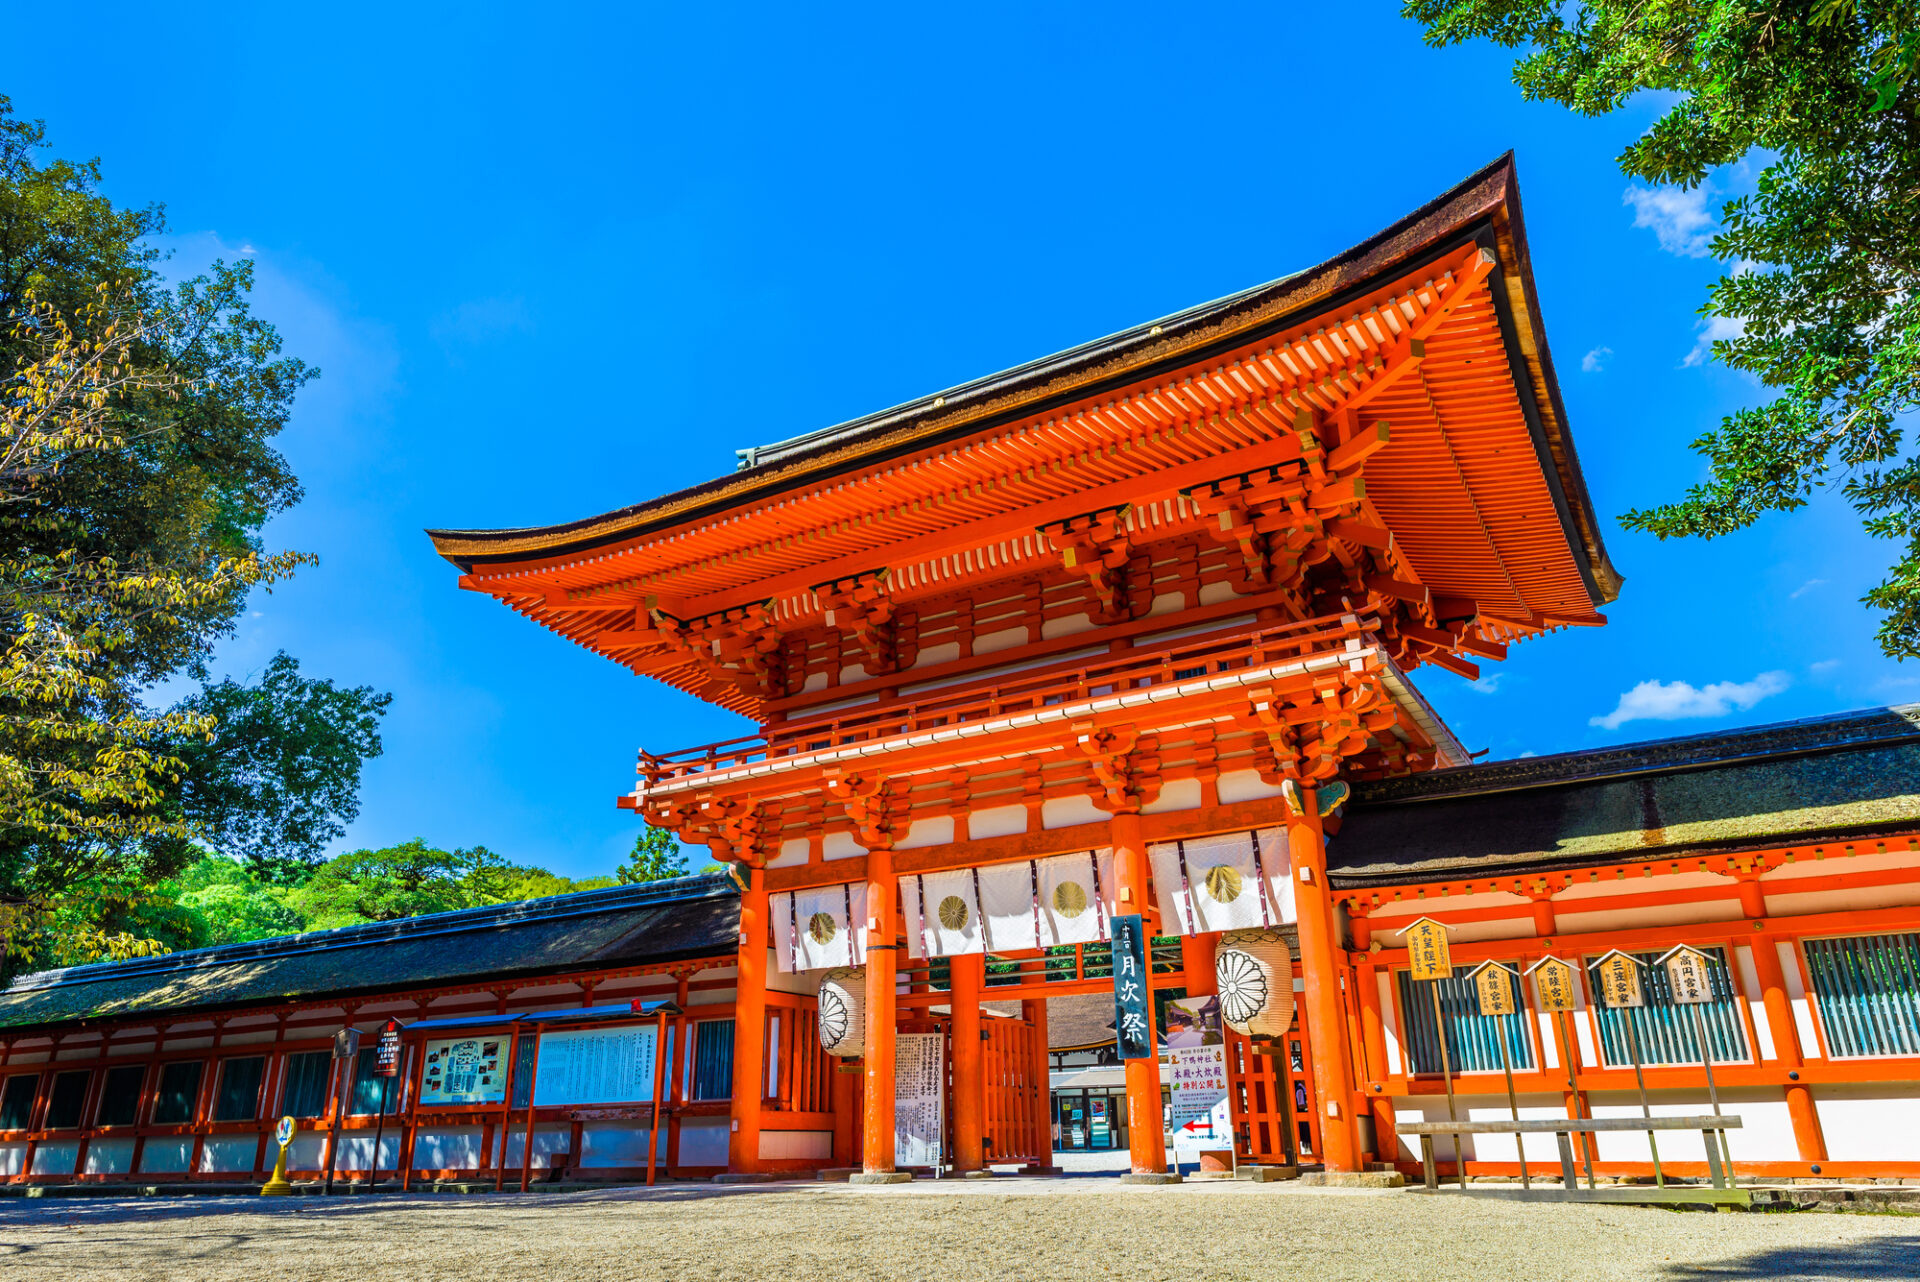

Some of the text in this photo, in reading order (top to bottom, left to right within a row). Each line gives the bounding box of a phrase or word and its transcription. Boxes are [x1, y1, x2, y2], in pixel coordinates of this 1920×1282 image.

[1420, 925, 1436, 975] 天皇陛下
[1120, 955, 1147, 1043] 月次祭
[1546, 965, 1565, 1008] 常陸宮家
[1612, 960, 1629, 1004] 三笠宮家
[1679, 955, 1699, 999] 高円宮家
[1181, 1054, 1213, 1065] 下鴨神社
[1182, 1079, 1215, 1091] 特別公開
